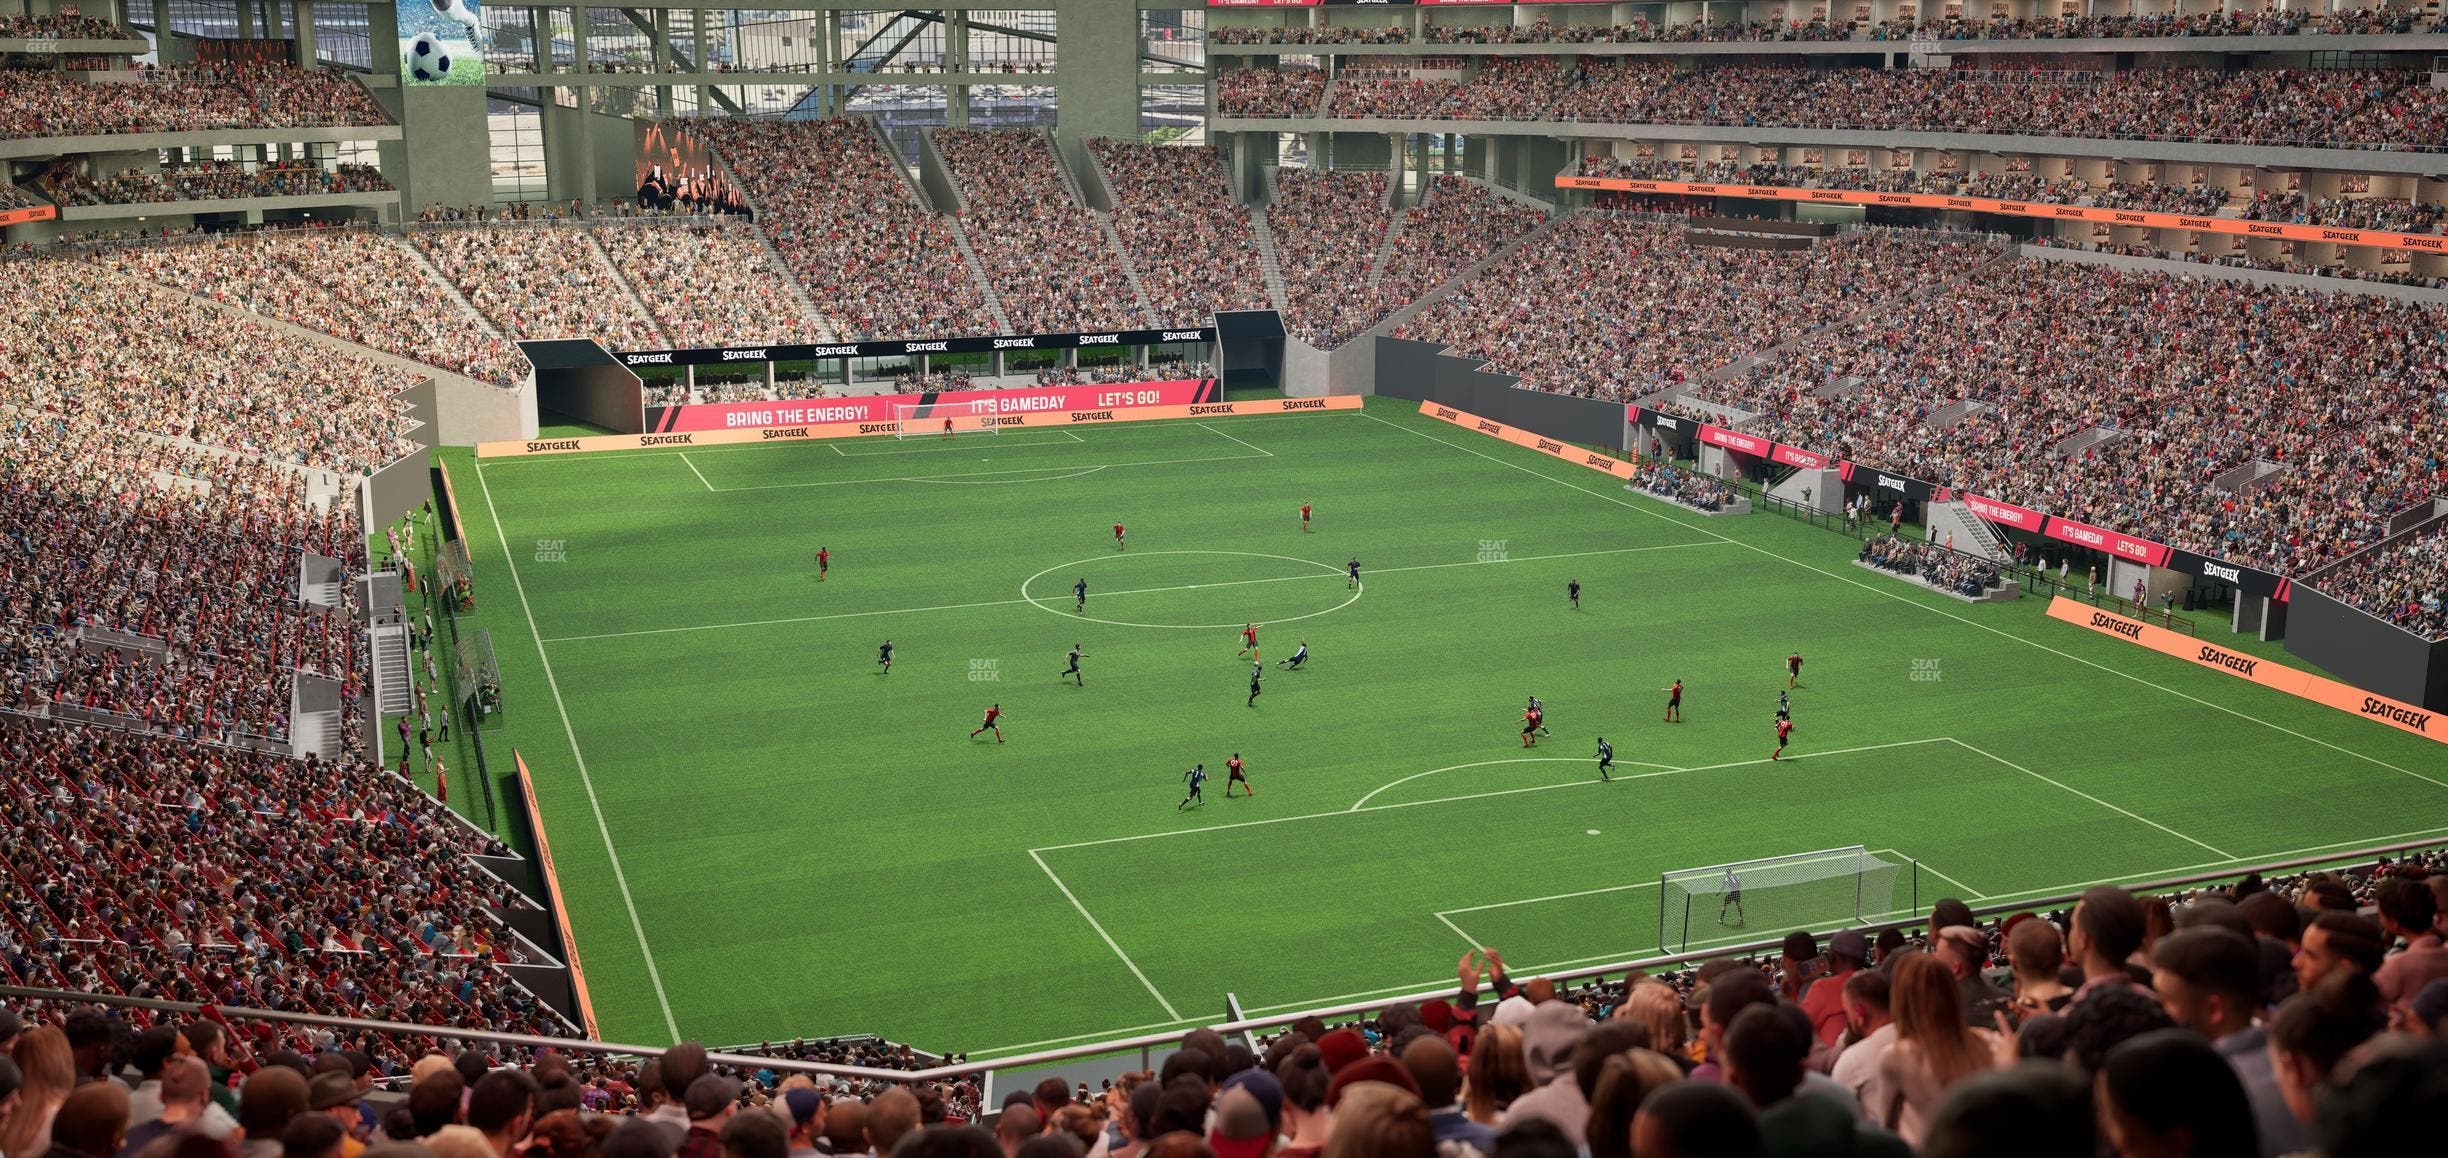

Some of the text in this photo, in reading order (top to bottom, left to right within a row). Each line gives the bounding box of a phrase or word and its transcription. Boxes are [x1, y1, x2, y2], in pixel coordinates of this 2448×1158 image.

[1630, 182, 1657, 190] SEATGEEK
[1688, 185, 1716, 193] SEATGEEK
[1748, 188, 1778, 196] SEATGEEK
[1812, 191, 1843, 200] SEATGEEK
[1879, 195, 1912, 204] SEATGEEK
[1948, 199, 1972, 208] SEATGEEK
[2000, 203, 2026, 212] SEATGEEK
[2055, 207, 2083, 217] SEATGEEK
[2115, 213, 2145, 223] SEATGEEK
[2179, 218, 2212, 229] SEATGEEK
[2248, 224, 2283, 235] SEATGEEK
[2323, 230, 2360, 242] SEATGEEK
[2403, 237, 2443, 249] SEATGEEK
[1079, 333, 1119, 345] SEATGEEK
[1162, 330, 1201, 341] SEATGEEK
[906, 341, 948, 352] SEATGEEK
[993, 337, 1035, 348] SEATGEEK
[722, 349, 767, 361] SEATGEEK
[815, 345, 859, 357] SEATGEEK
[627, 353, 672, 365] SEATGEEK
[971, 395, 1066, 414] IT'S GAMEDAY
[1098, 390, 1160, 407] LET'S GO!
[1190, 404, 1234, 416] SEATGEEK
[1283, 400, 1326, 410] SEATGEEK
[726, 406, 868, 427] BRING THE ENERGY!
[1071, 411, 1113, 422] SEATGEEK
[1436, 407, 1458, 422] SEATGEEK
[981, 415, 1024, 427] SEATGEEK
[1656, 415, 1678, 430] SEATGEEK
[763, 427, 809, 439] SEATGEEK
[1478, 420, 1502, 435] SEATGEEK
[526, 440, 580, 452] SEATGEEK
[640, 434, 692, 446] SEATGEEK
[1537, 438, 1563, 455] SEATGEEK
[1586, 454, 1615, 471] SEATGEEK
[1878, 474, 1906, 493] SEATGEEK
[1989, 505, 2000, 517] THE
[1999, 508, 2023, 523] ENERGY!
[2062, 525, 2104, 545] IT'S GAMEDAY
[2117, 539, 2133, 554] LET'S
[2203, 561, 2240, 584] SEATGEEK
[2090, 612, 2143, 640] SEATGEEK
[2198, 646, 2258, 677] SEATGEEK
[2360, 697, 2431, 732] SEATGEEK
